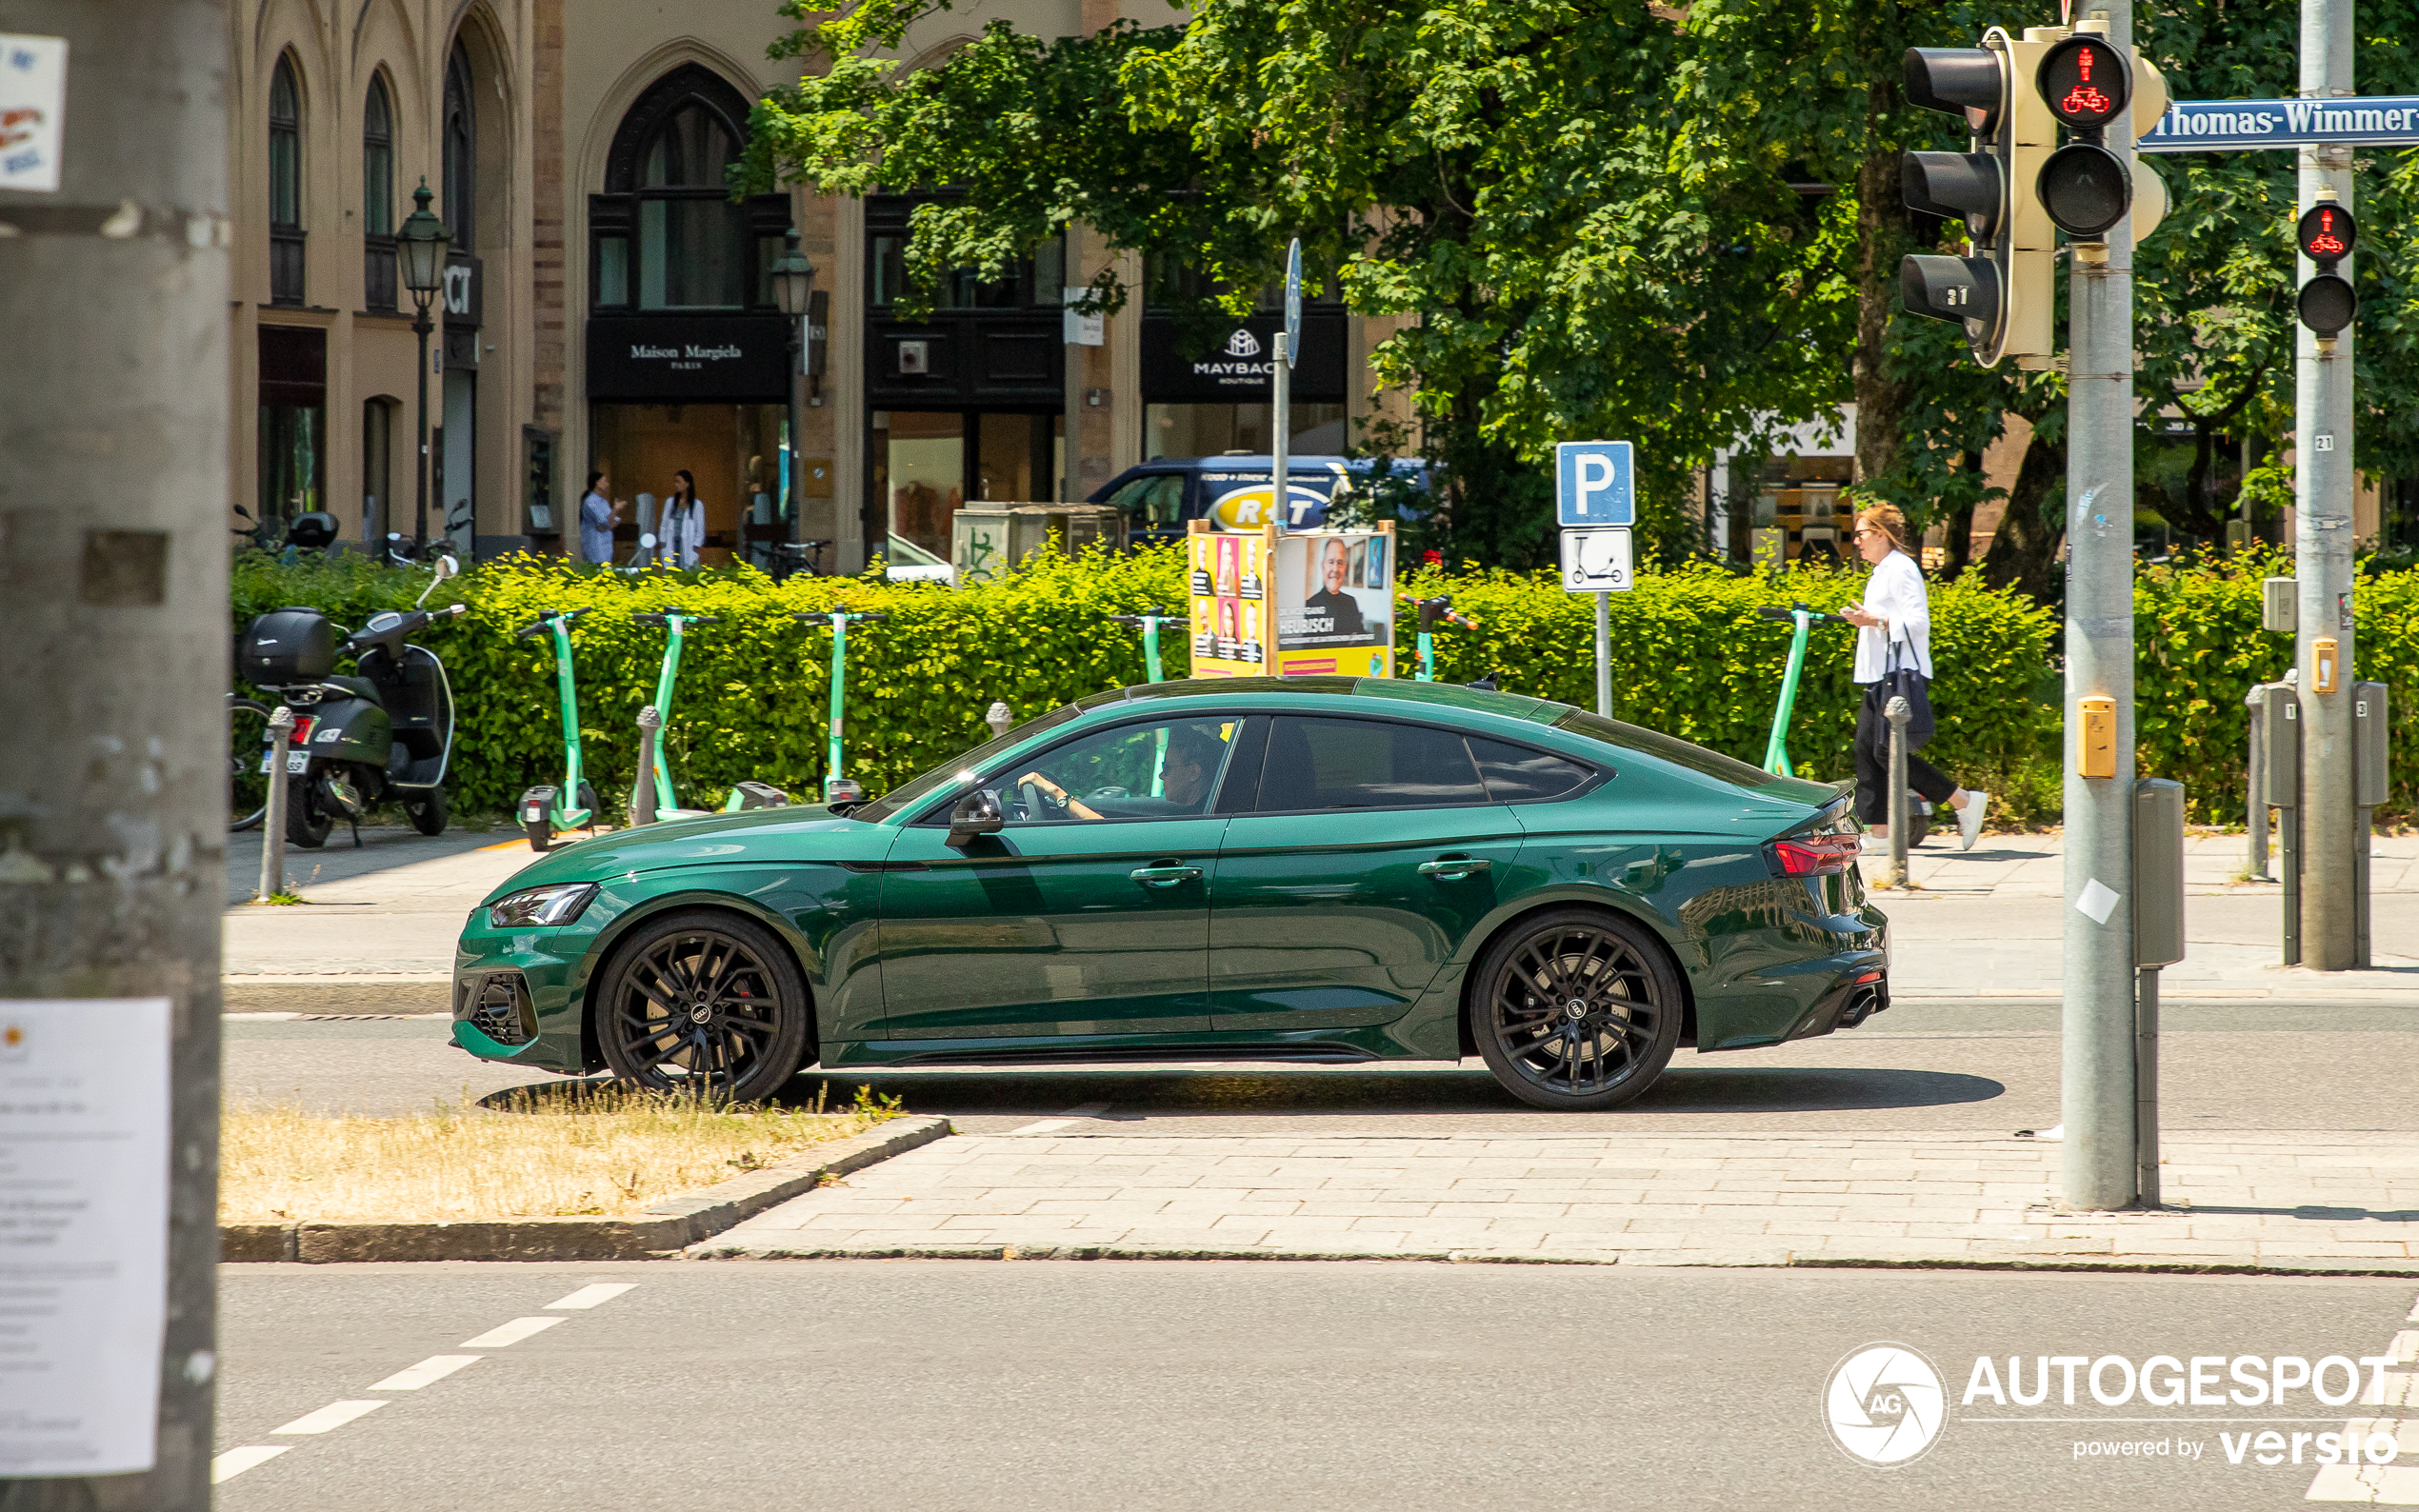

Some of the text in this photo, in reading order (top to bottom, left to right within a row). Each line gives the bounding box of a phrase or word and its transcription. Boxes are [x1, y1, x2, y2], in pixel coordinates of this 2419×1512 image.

[630, 344, 742, 361] Maison Margiela
[670, 361, 703, 369] PARIS
[1193, 362, 1274, 374] MAYBAC
[2317, 437, 2331, 448] 21
[1575, 453, 1615, 515] P
[1279, 617, 1334, 634] HEUBISCH
